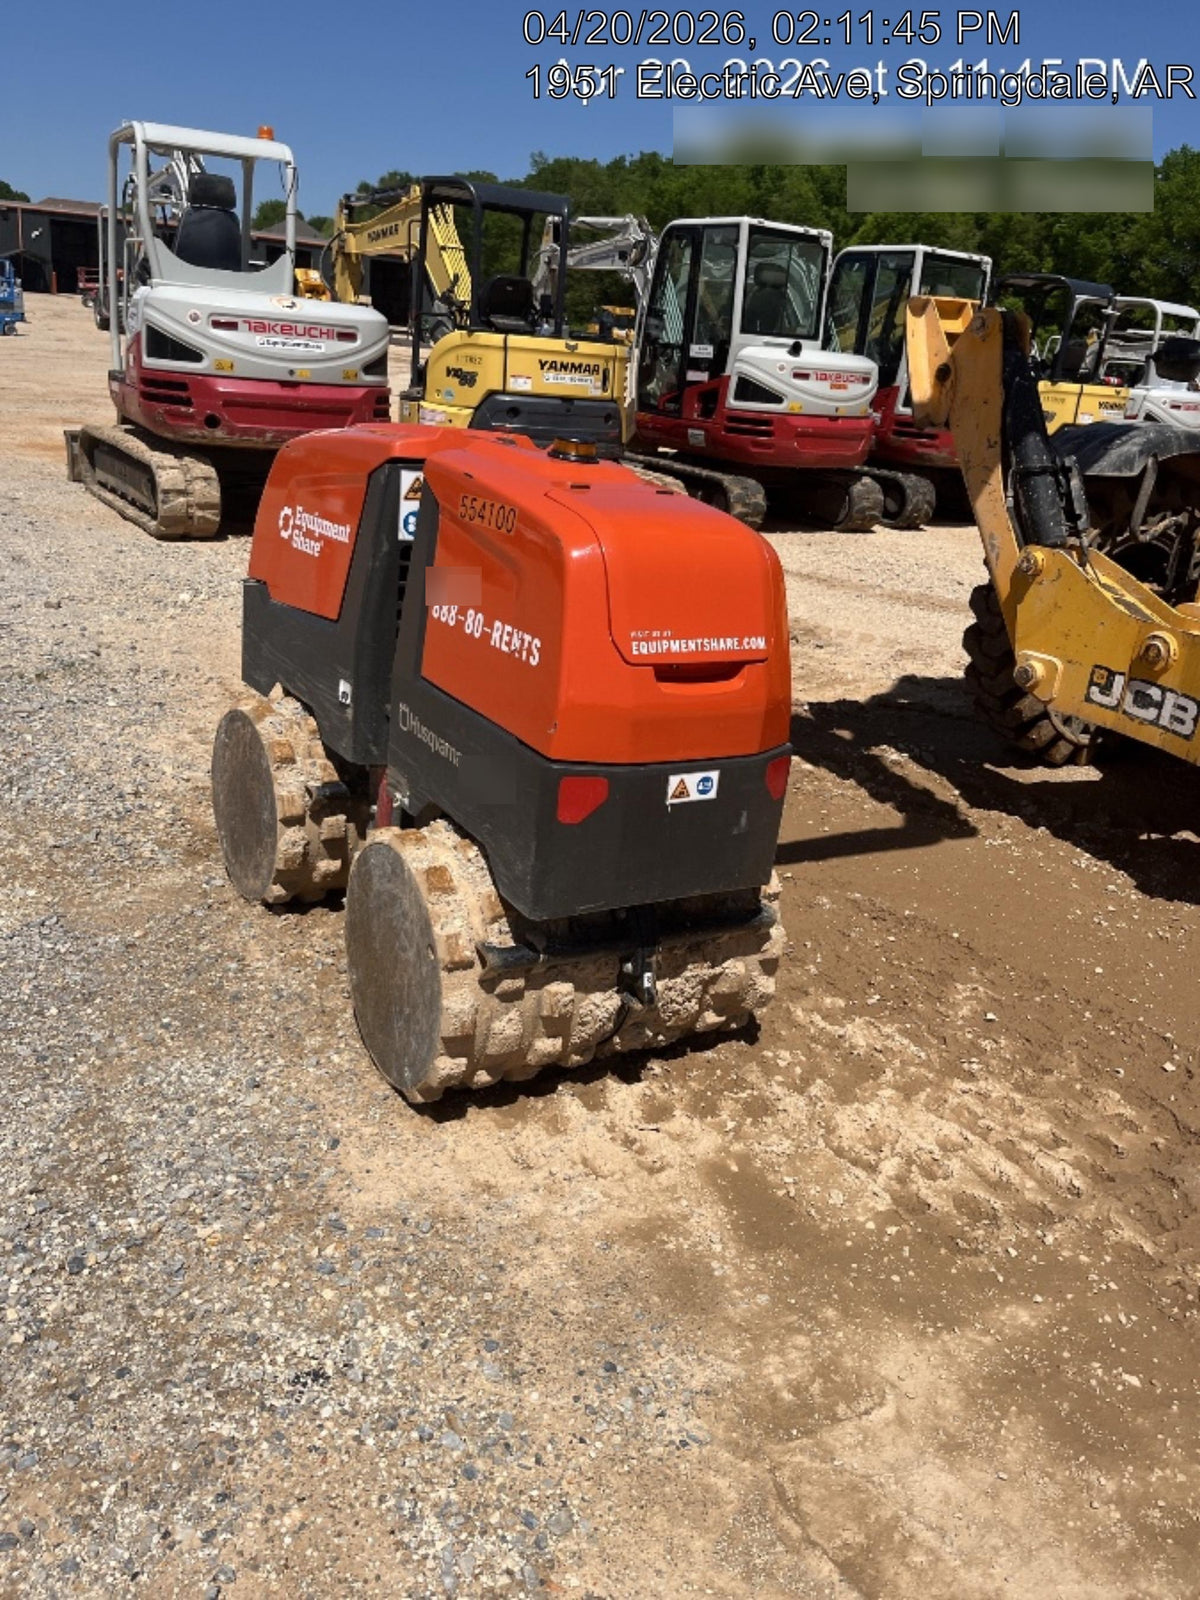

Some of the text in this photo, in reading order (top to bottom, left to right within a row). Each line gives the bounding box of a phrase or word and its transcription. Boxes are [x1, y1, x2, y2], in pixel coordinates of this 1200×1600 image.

[538, 358, 600, 376] YANMAR
[295, 505, 351, 543] Equipment
[460, 495, 516, 534] 554100
[292, 529, 321, 557] Share
[632, 637, 766, 654] EQUIPMENTSHARE.COM
[1087, 672, 1198, 737] JCB
